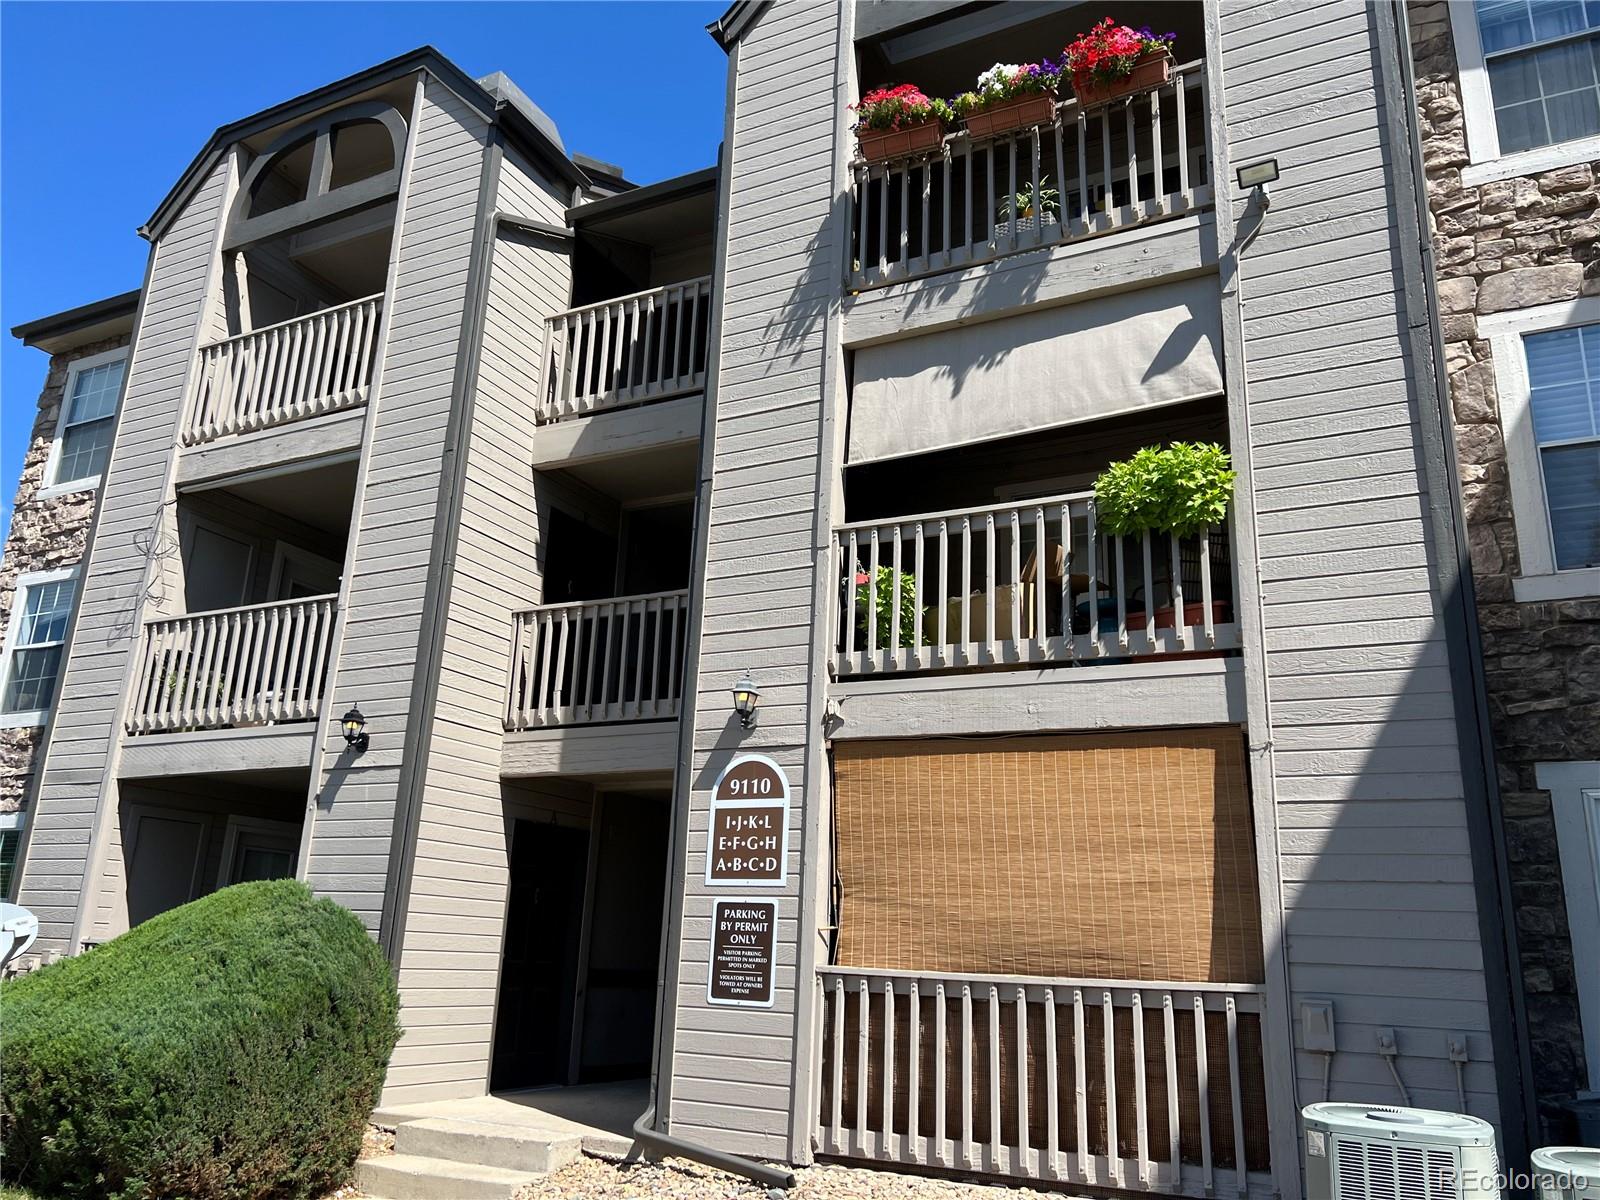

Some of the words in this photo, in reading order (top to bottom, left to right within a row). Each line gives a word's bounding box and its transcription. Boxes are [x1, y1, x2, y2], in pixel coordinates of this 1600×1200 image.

[730, 778, 771, 794] 9110
[724, 909, 766, 919] PARKING
[721, 922, 732, 930] BY
[735, 922, 768, 932] PERMIT
[730, 935, 756, 944] ONLY
